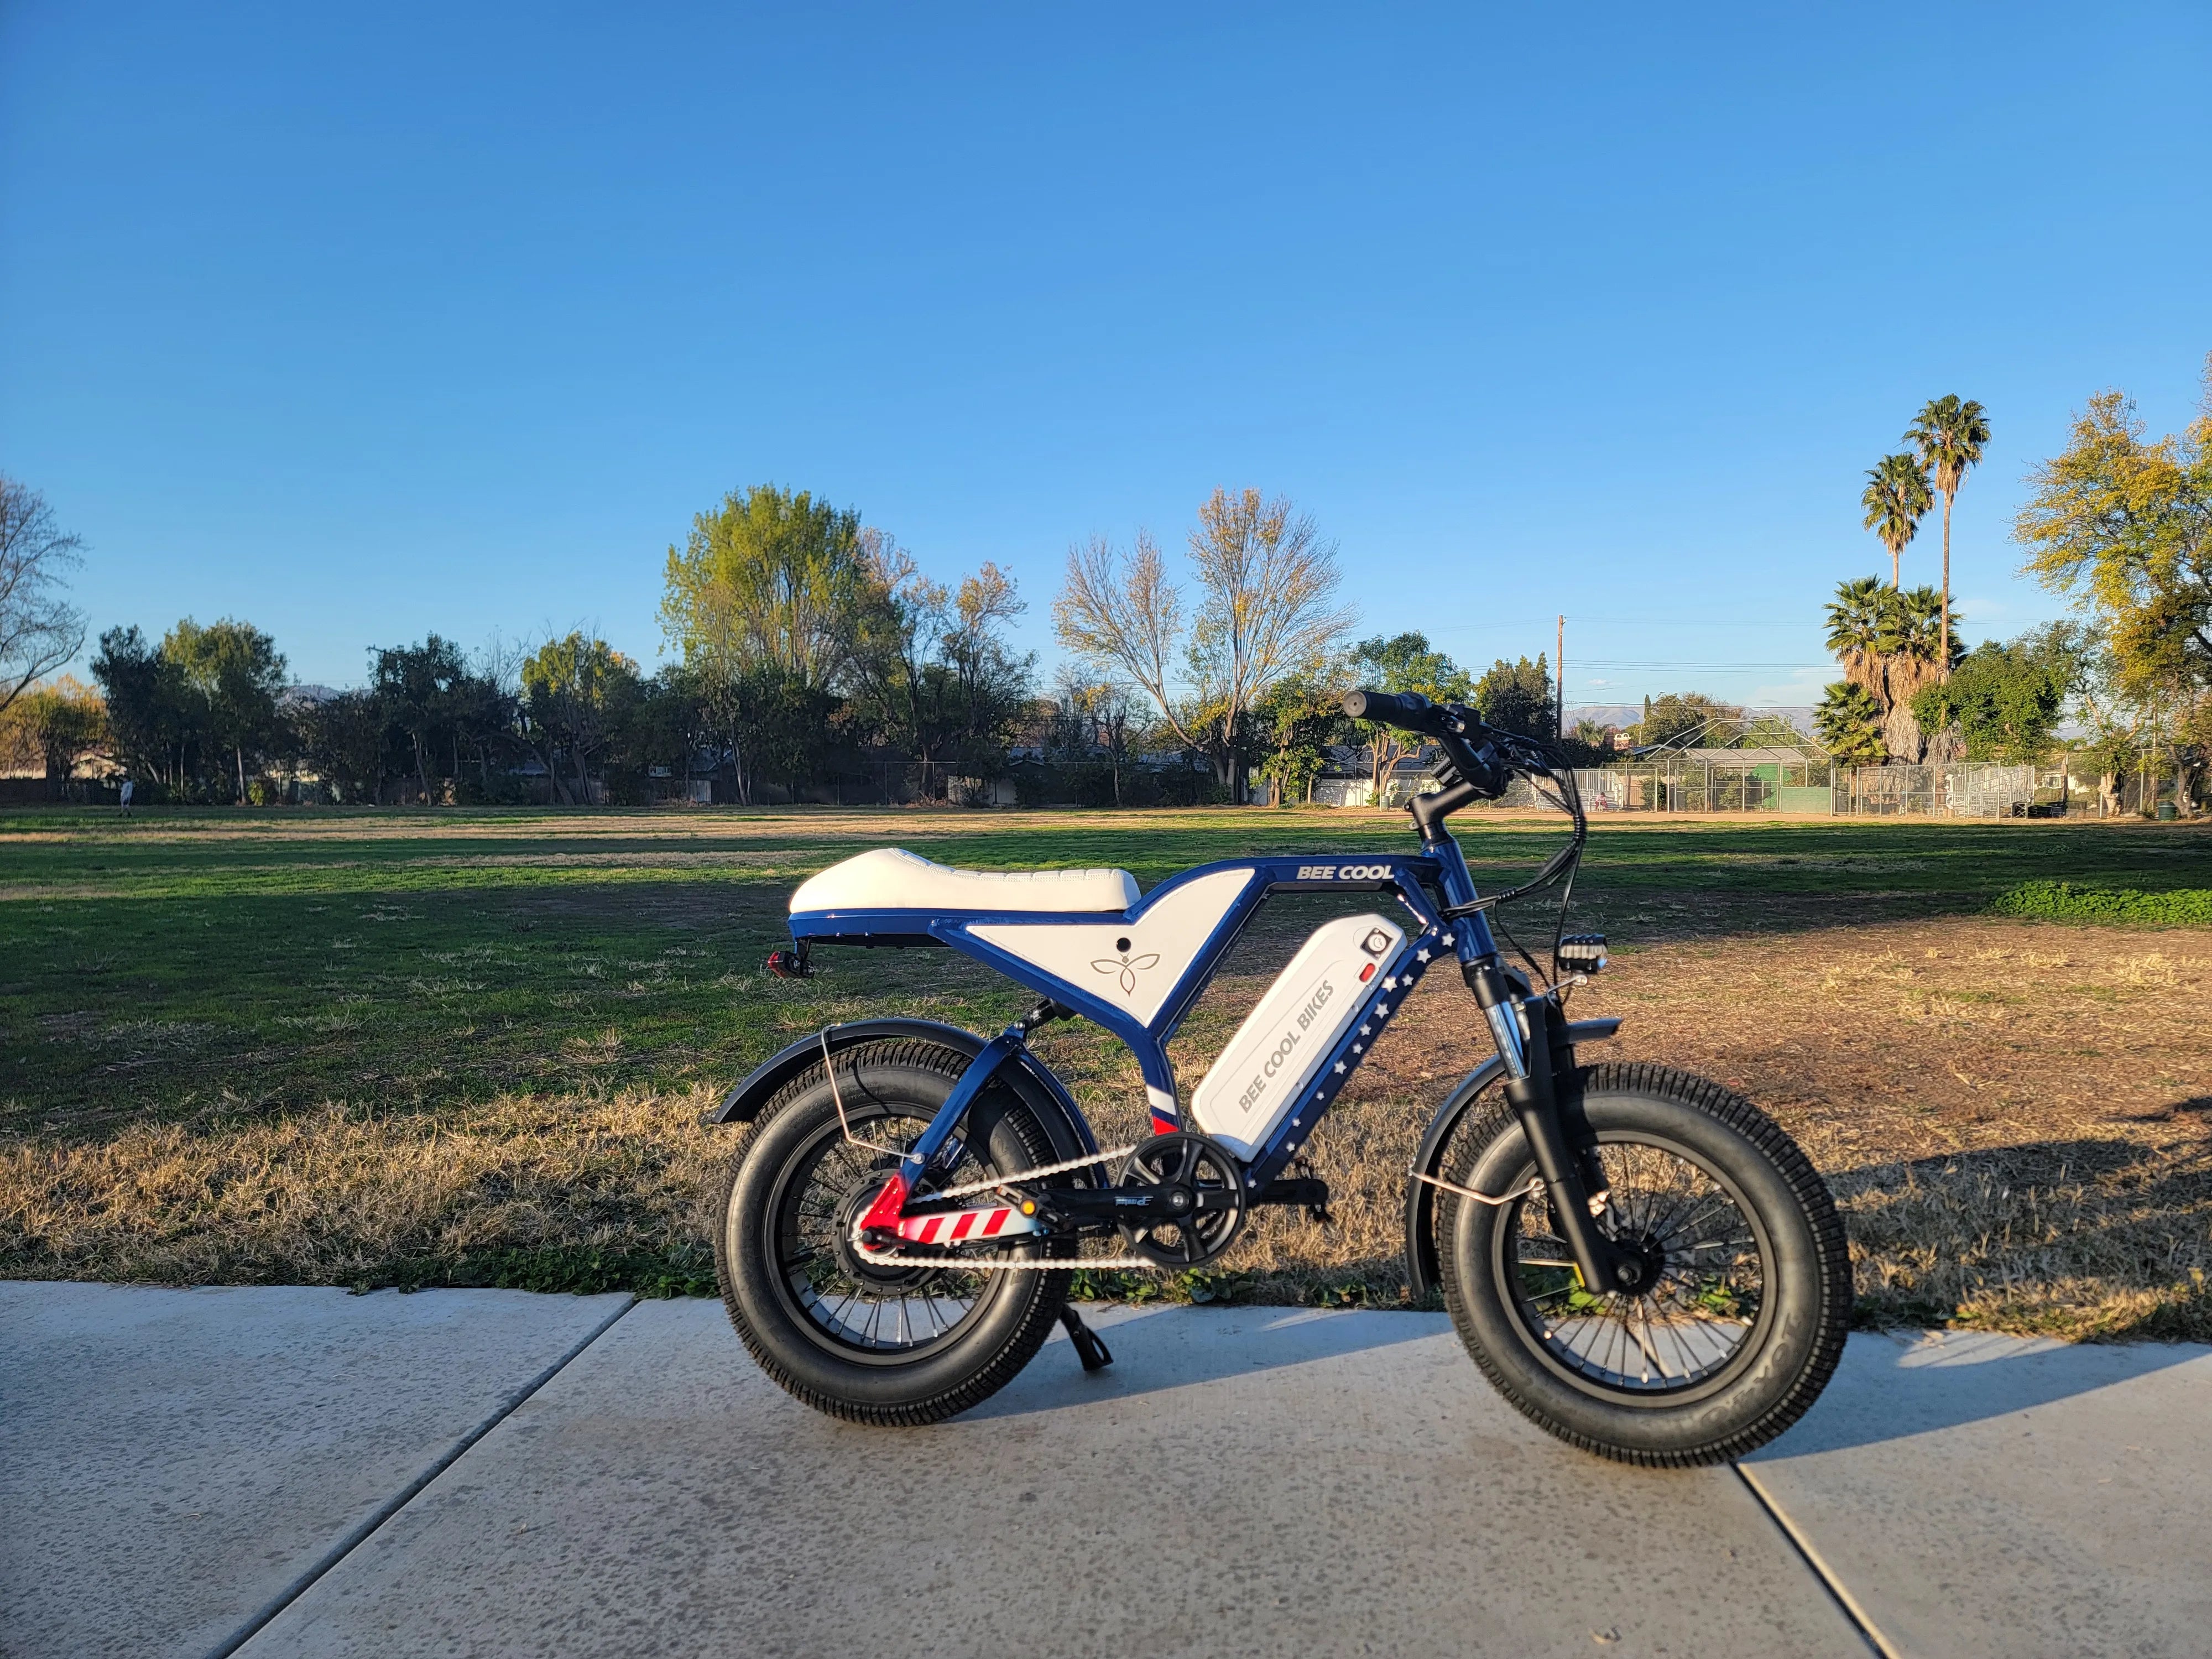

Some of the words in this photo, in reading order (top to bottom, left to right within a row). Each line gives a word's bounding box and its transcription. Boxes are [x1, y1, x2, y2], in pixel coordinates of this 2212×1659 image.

[1296, 865, 1337, 880] BEE
[1338, 865, 1395, 880] COOL
[1239, 1074, 1266, 1114] BEE
[1264, 1031, 1301, 1078] COOL
[1297, 979, 1334, 1032] BIKES
